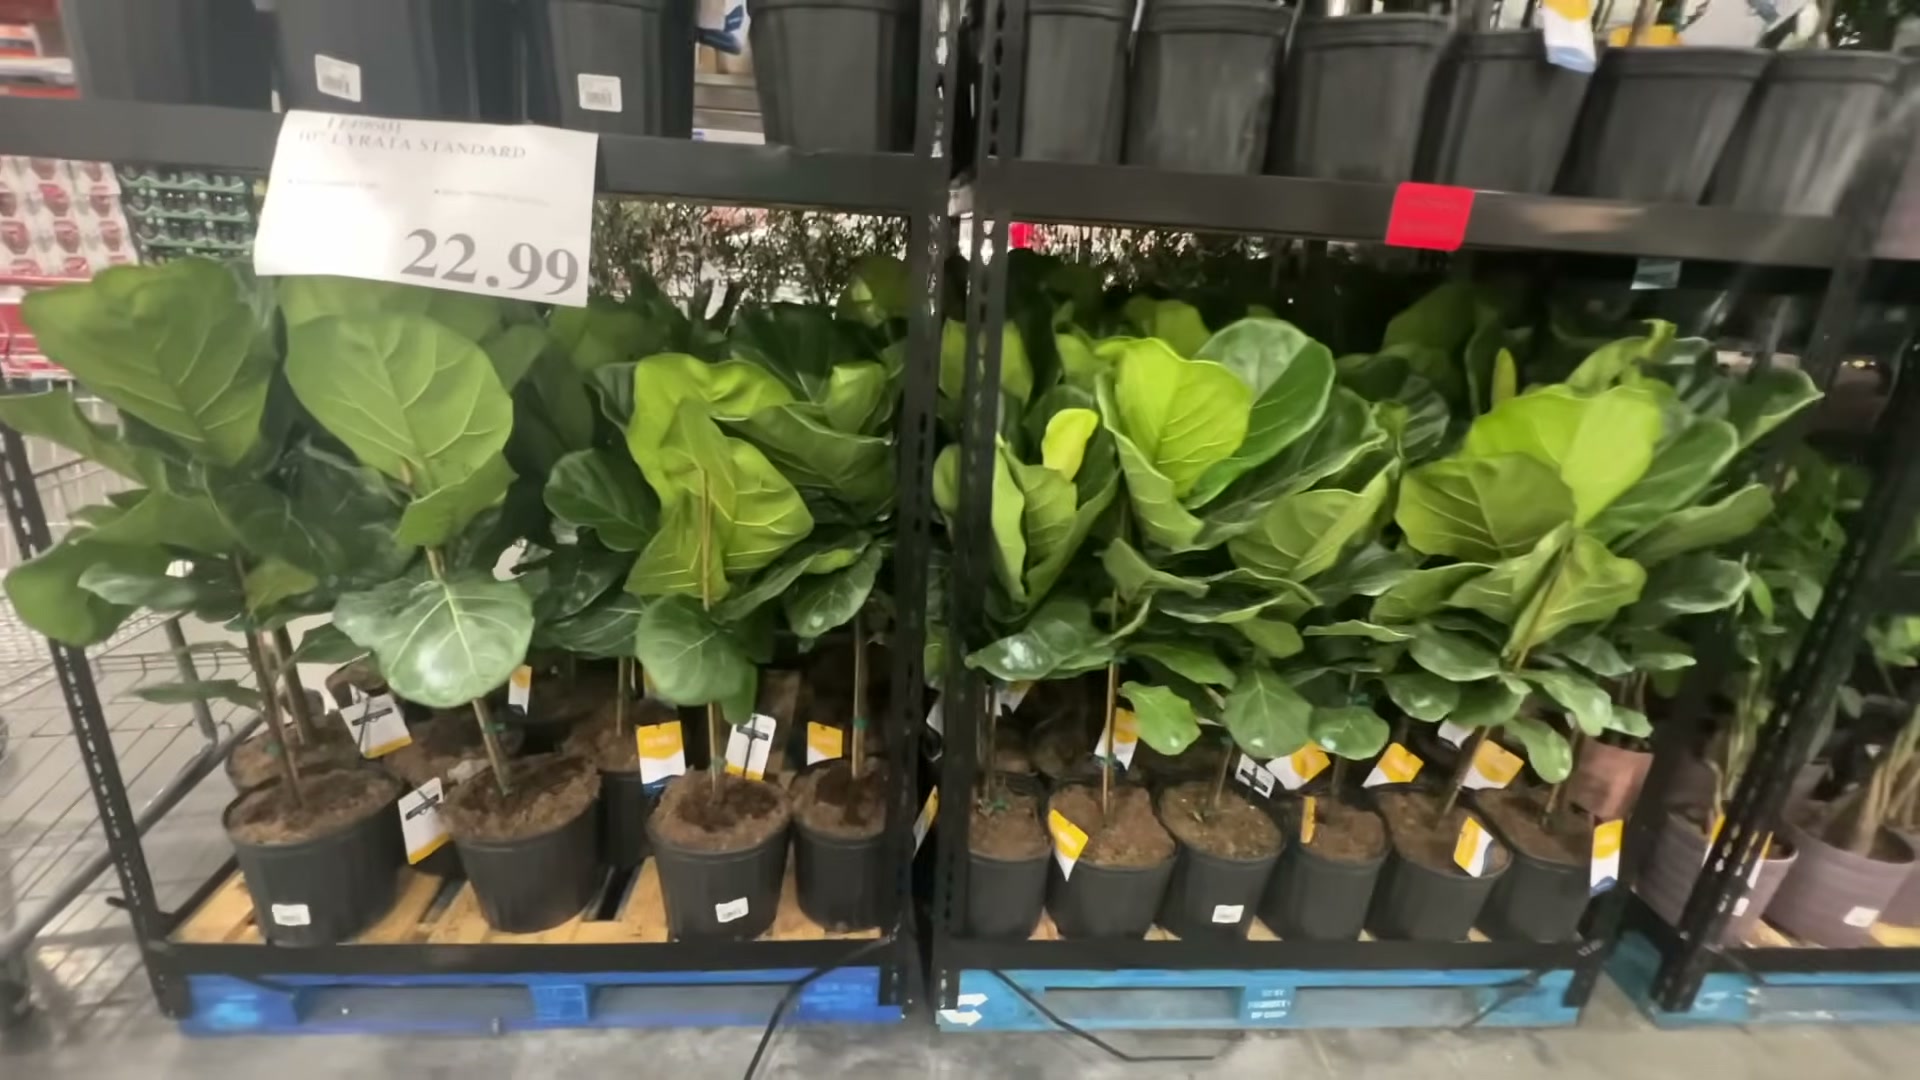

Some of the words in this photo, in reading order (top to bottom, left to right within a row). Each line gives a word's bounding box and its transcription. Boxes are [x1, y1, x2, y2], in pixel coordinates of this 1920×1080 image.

[331, 132, 411, 151] LYRATA
[420, 138, 527, 159] STANDARD
[401, 229, 578, 295] 22.99
